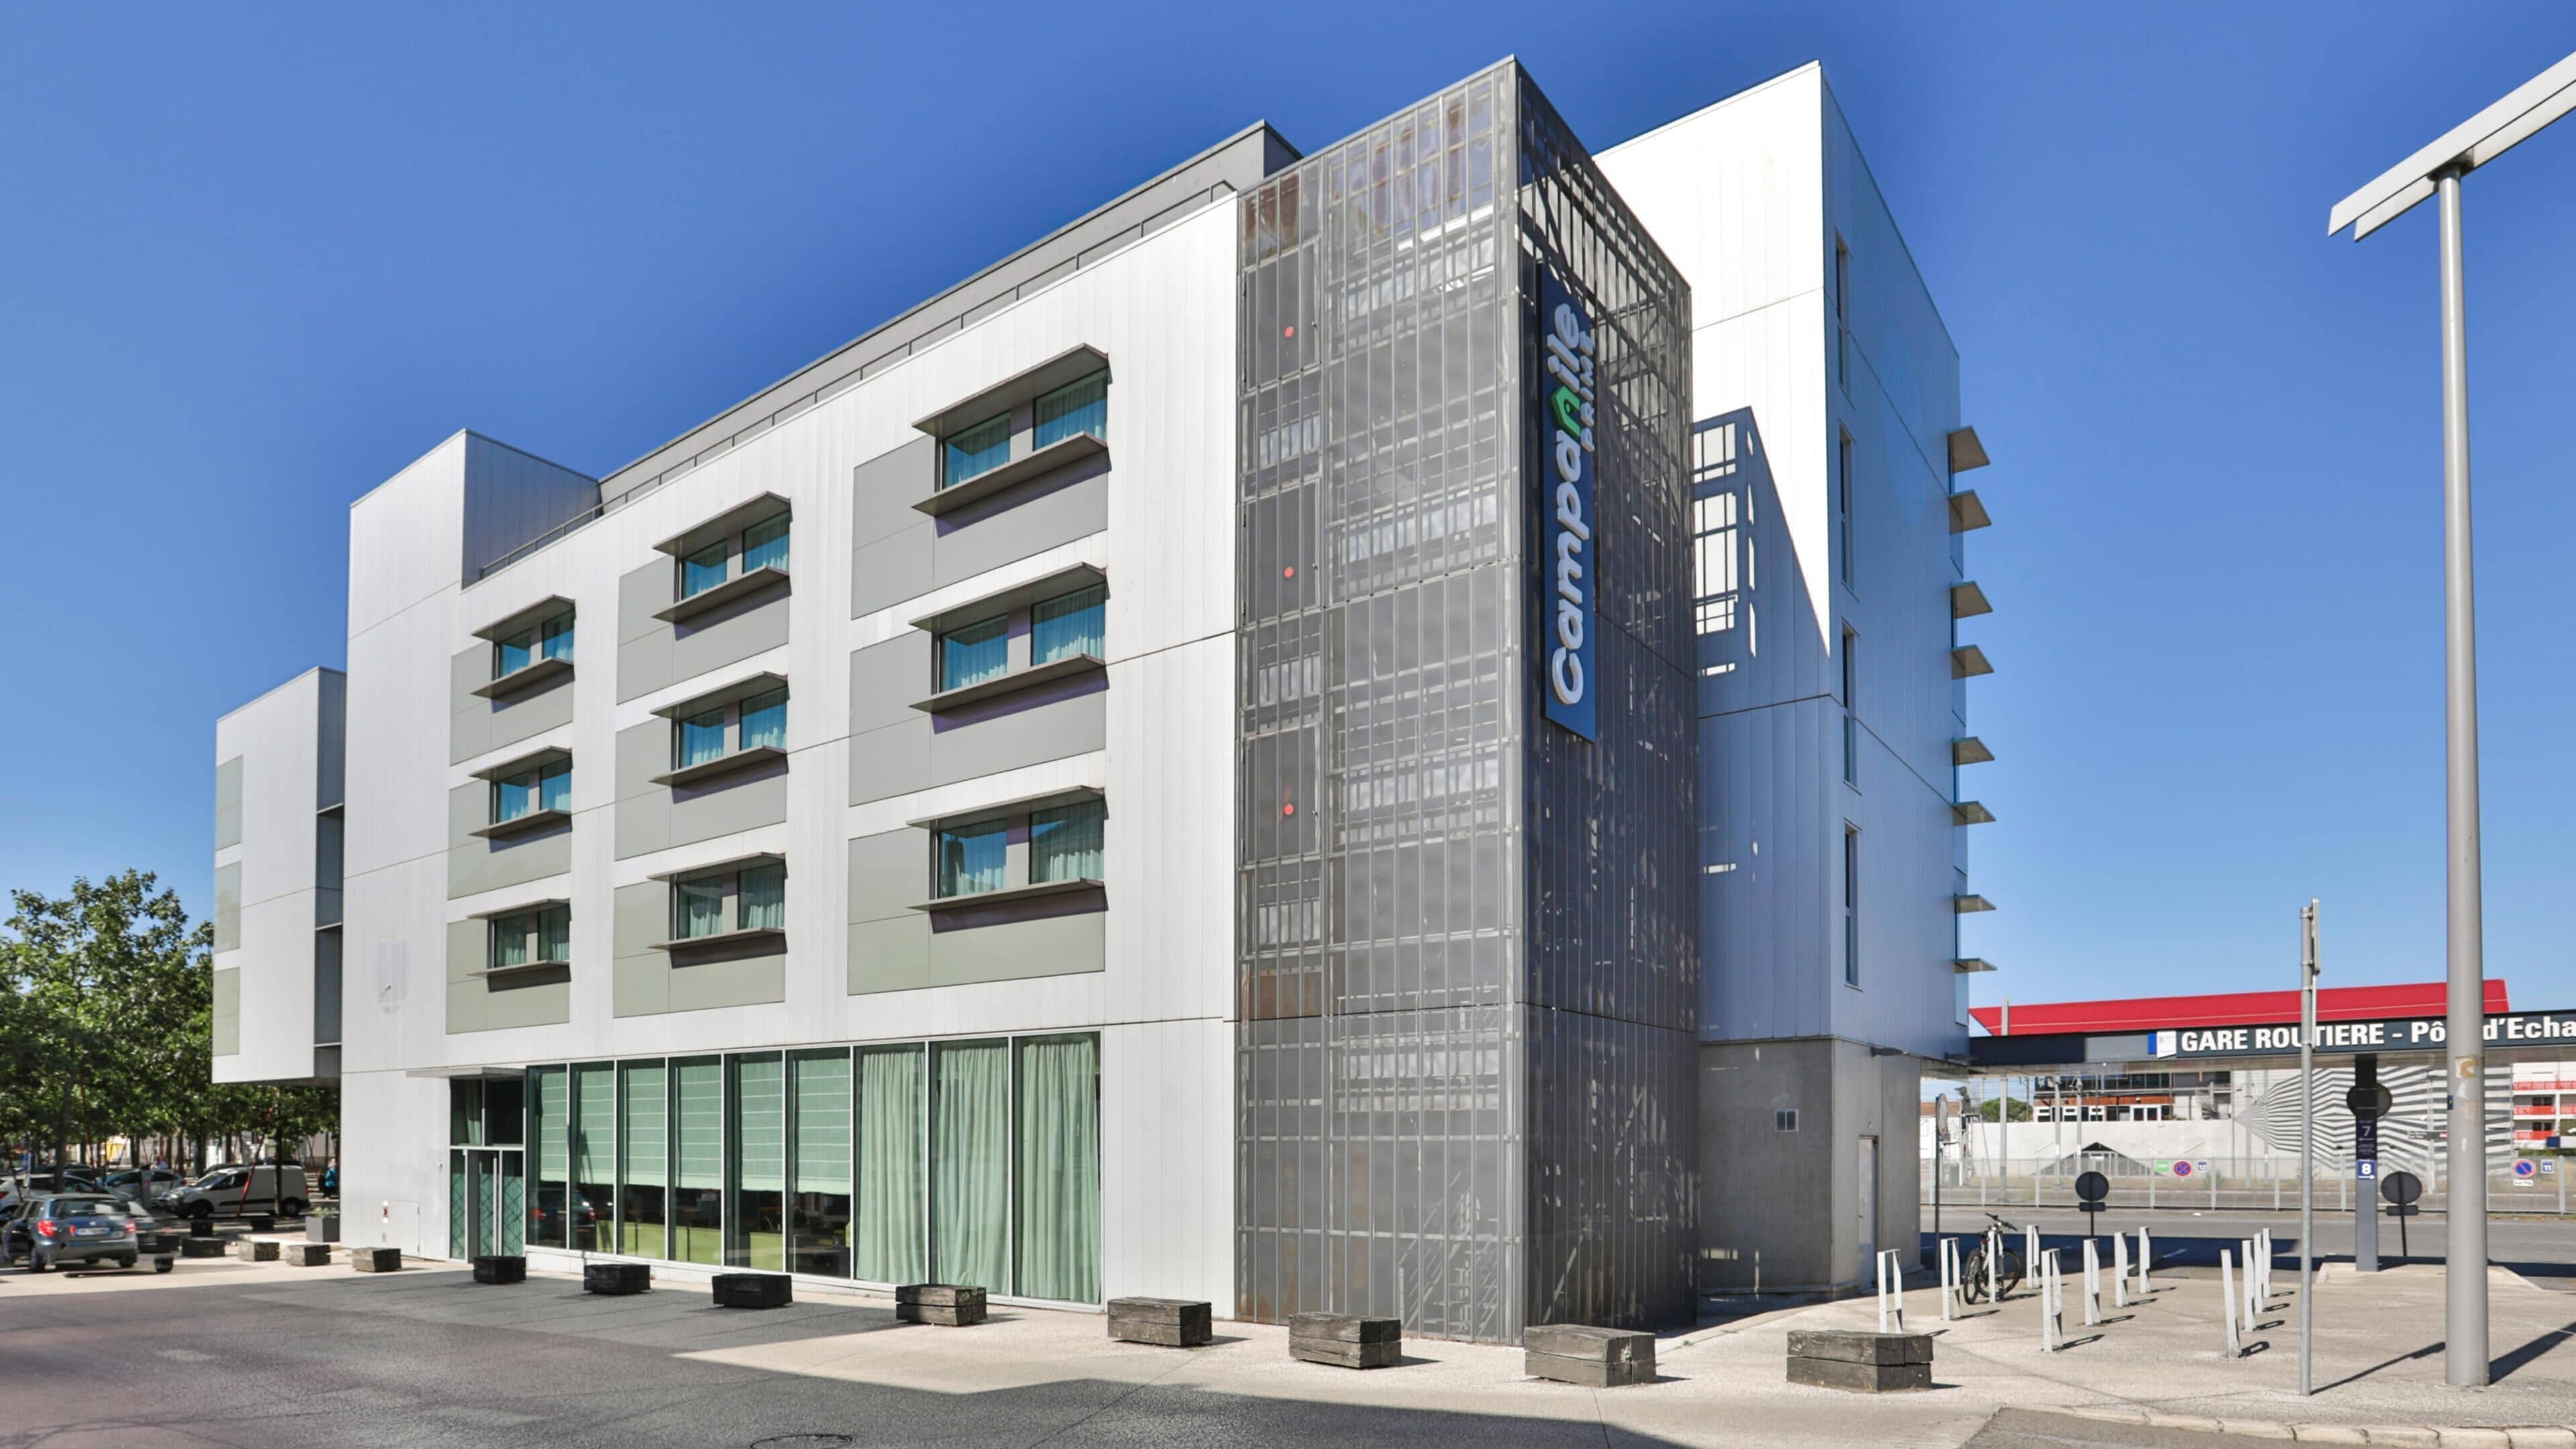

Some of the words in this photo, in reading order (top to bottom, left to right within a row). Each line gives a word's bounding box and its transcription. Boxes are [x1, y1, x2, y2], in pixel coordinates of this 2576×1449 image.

[1579, 331, 1595, 451] PRIME
[1547, 303, 1590, 705] Campanile
[2181, 1030, 2248, 1052] GARE
[2255, 1023, 2385, 1049] ROUTIERE
[2411, 1020, 2447, 1043] Pô
[2362, 1126, 2371, 1137] 7
[2361, 1163, 2371, 1175] 8
